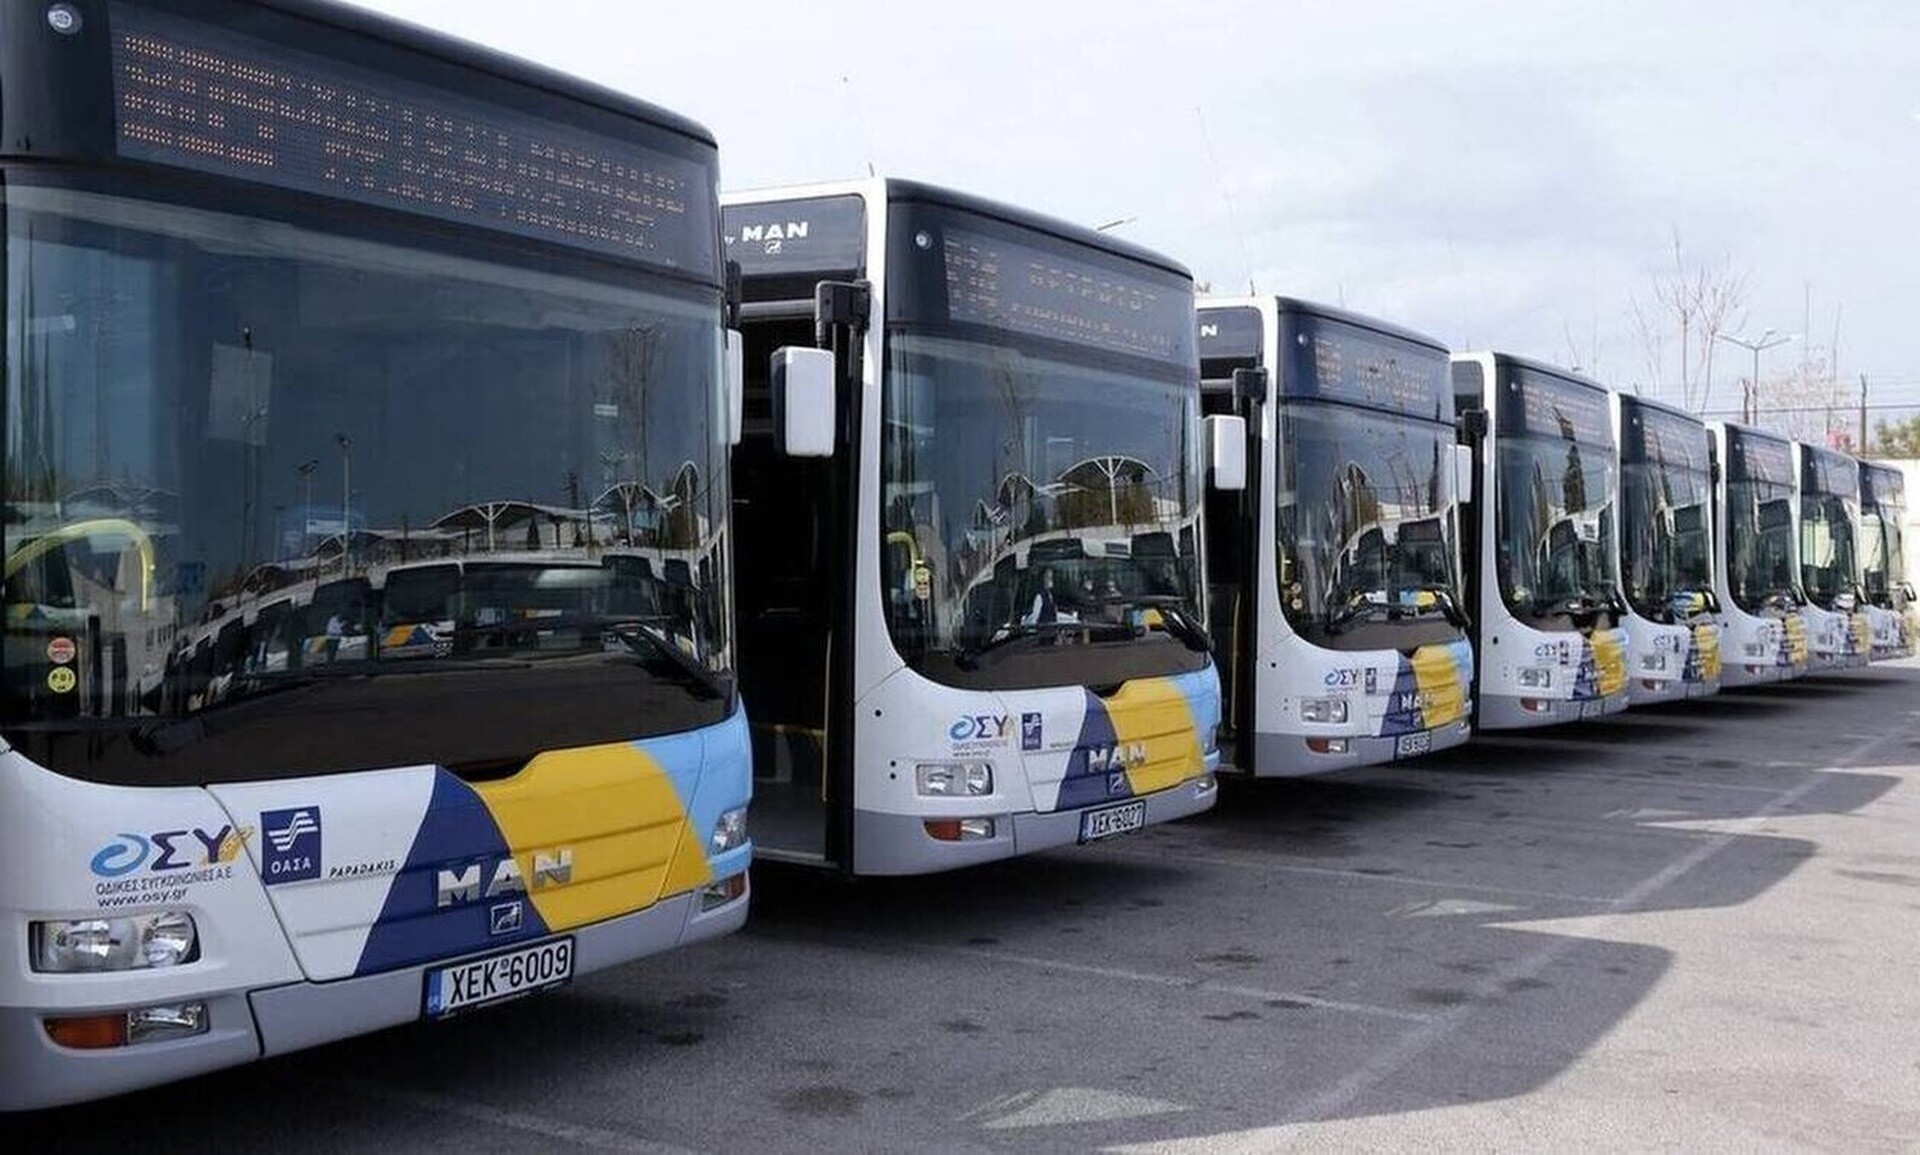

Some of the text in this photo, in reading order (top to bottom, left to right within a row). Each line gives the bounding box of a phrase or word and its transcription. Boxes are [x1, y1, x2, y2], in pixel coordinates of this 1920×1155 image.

[742, 221, 809, 242] MAN
[1088, 744, 1146, 773] MAN
[271, 856, 312, 875] ΟΑΣΑ
[329, 859, 396, 878] PAPADAKIS
[437, 848, 572, 907] MAN
[97, 887, 189, 907] www.osy.gr
